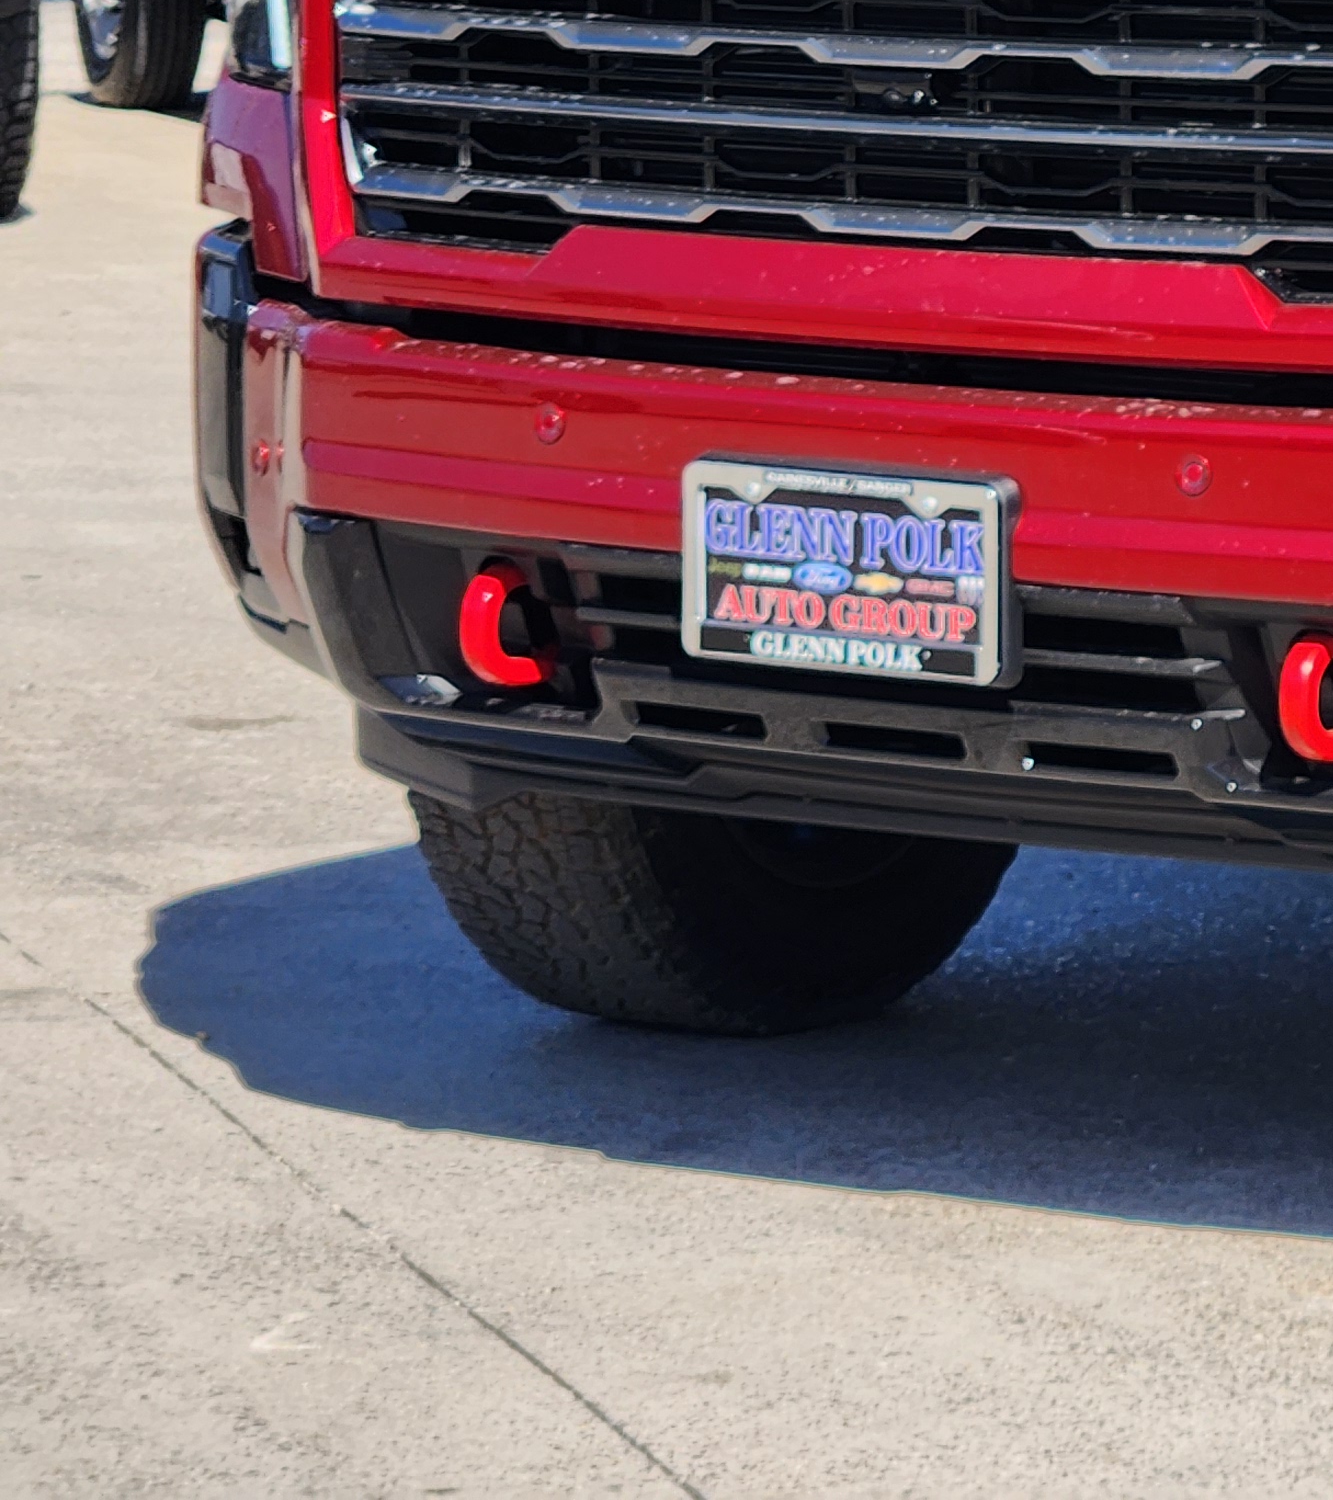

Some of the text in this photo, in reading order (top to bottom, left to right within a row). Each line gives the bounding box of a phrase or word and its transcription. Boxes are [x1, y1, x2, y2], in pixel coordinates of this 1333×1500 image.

[766, 471, 848, 488] GAINESVILLE
[705, 498, 984, 576] GLENN POLK
[714, 583, 977, 643] AUTO GROUP
[750, 631, 923, 672] GLENN POLK
